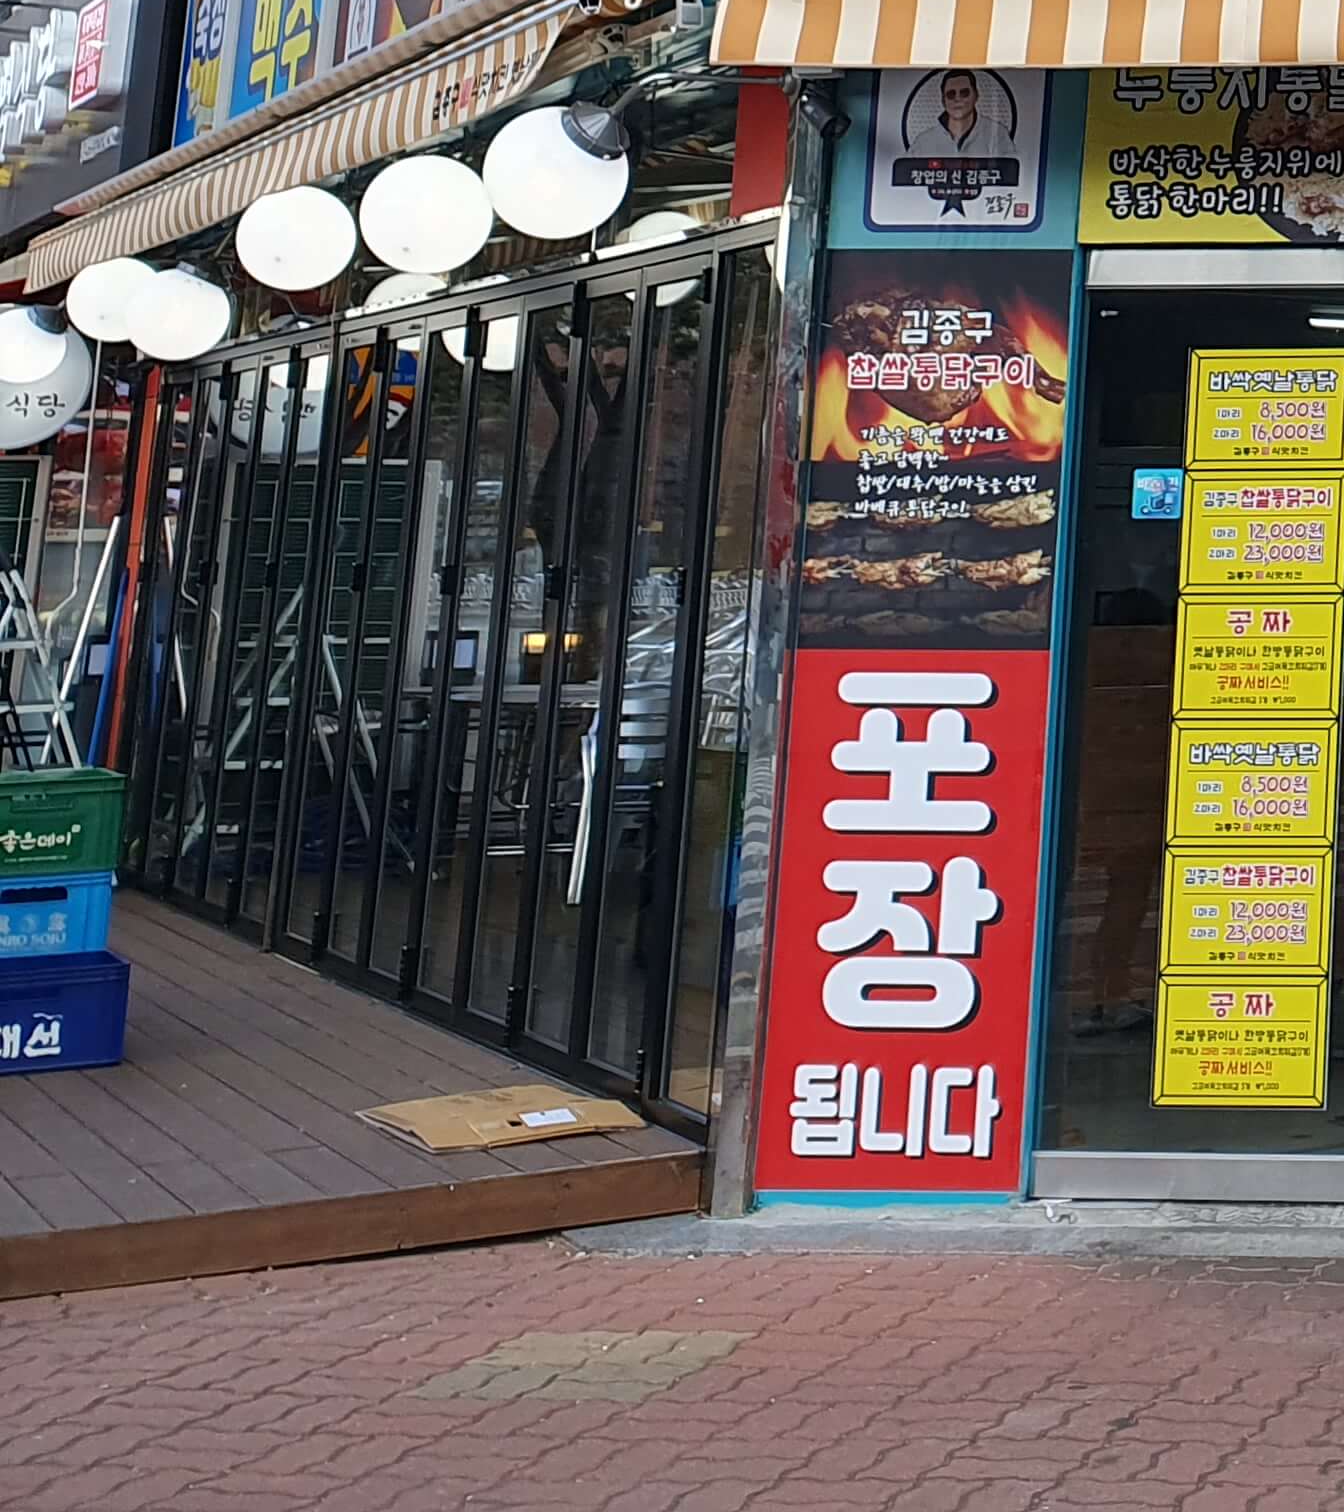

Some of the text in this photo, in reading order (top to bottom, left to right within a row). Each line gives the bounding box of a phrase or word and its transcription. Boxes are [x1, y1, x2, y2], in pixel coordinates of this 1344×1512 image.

[1110, 148, 1344, 179] 바삭한 누룽지위에
[911, 169, 1001, 185] 창업의 신 김종구
[1107, 183, 1283, 216] 통닭 한마리!!
[901, 309, 993, 345] 김종구
[846, 353, 1035, 390] 찹쌀통닭구이
[1209, 370, 1338, 392] 바싹옛날통닭
[1217, 402, 1326, 421] 1마리 8,500원
[1213, 424, 1326, 443] 2마리 16,000원
[1203, 487, 1332, 508] 김종구 찹쌀통닭구이
[1212, 523, 1324, 544] 1마리 12,000원
[1208, 545, 1323, 565] 2마리 23,000원
[1189, 743, 1321, 765] 바싹옛날통닭
[1198, 776, 1308, 796] 1마리 8,500원
[1194, 799, 1307, 819] 2마리 16,000원
[0, 830, 72, 853] 좋은데이
[816, 673, 1000, 1029] 포장
[1185, 866, 1314, 886] 김종구 찹쌀통닭구이
[1193, 902, 1307, 924] 1마리 12,000원
[1190, 925, 1306, 946] 2마리 23,000원
[790, 1062, 1000, 1158] 됩니다
